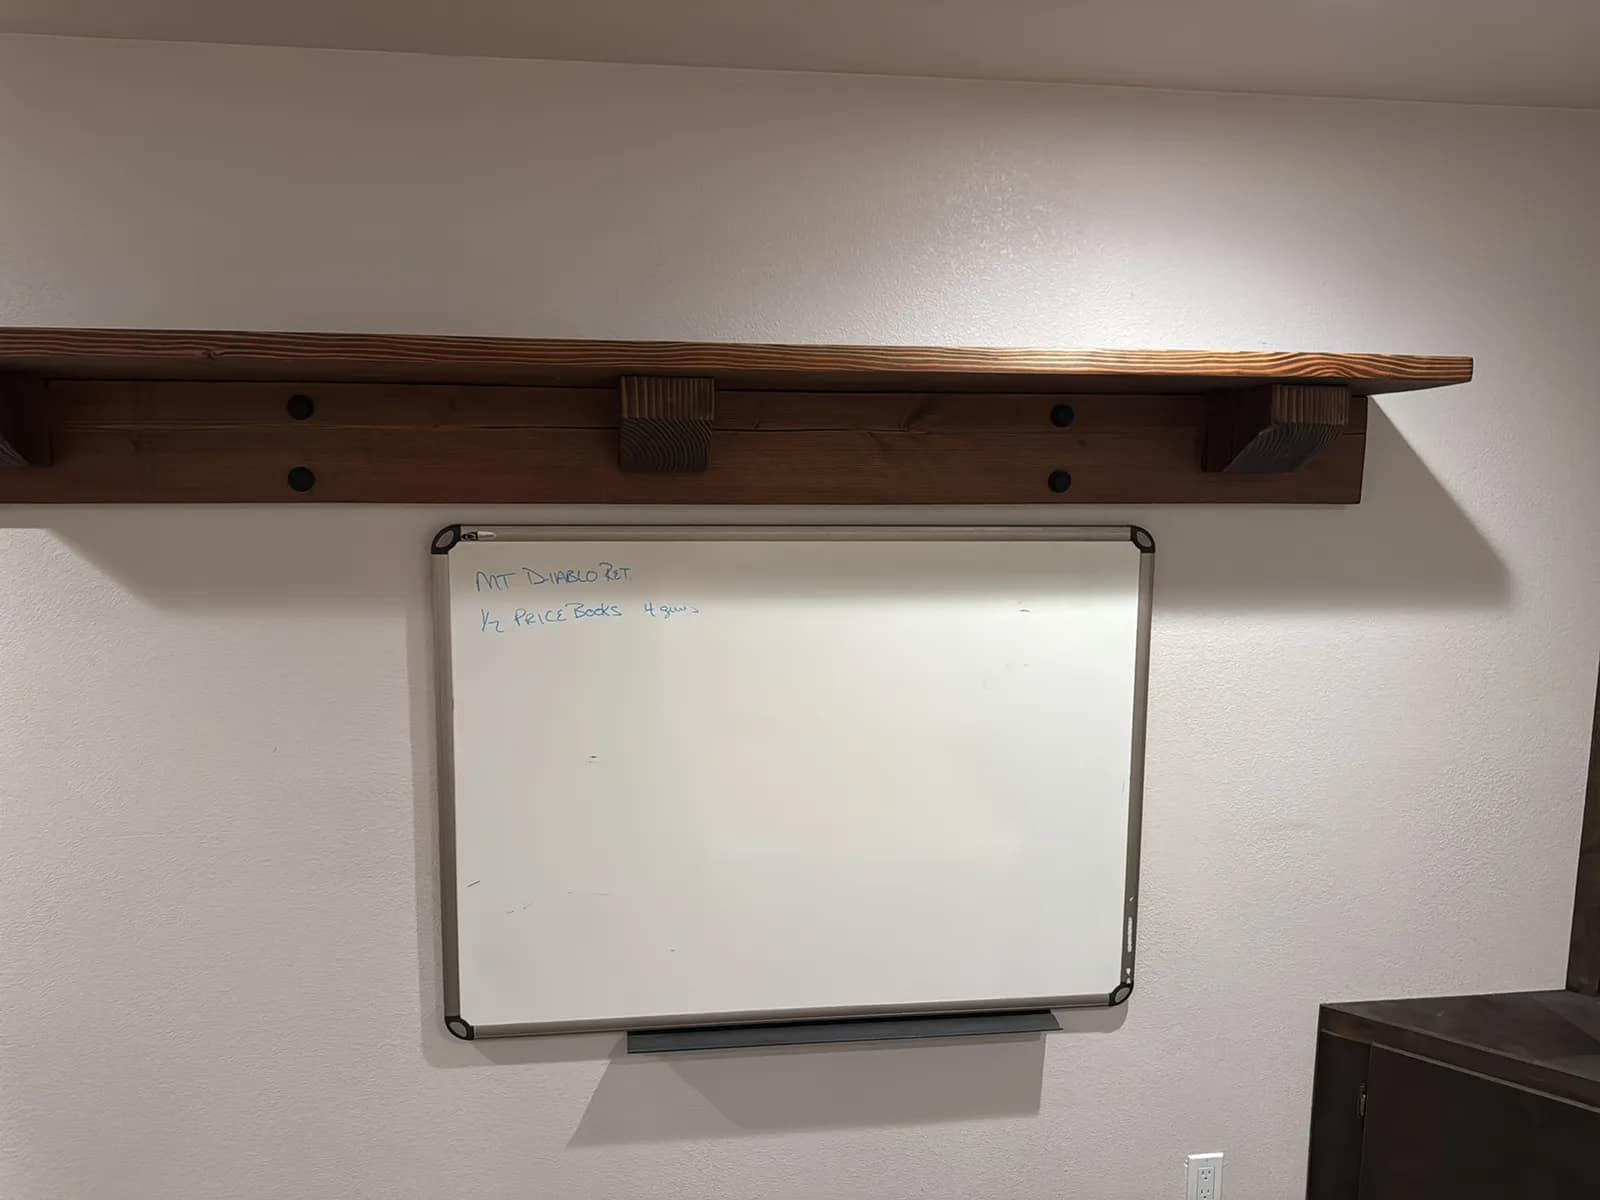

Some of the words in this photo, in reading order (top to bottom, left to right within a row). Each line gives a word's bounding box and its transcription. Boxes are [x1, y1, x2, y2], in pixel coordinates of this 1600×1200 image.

[475, 571, 515, 592] MT
[521, 567, 598, 585] DIABLO
[513, 608, 567, 626] PRICE
[644, 601, 655, 617] 4
